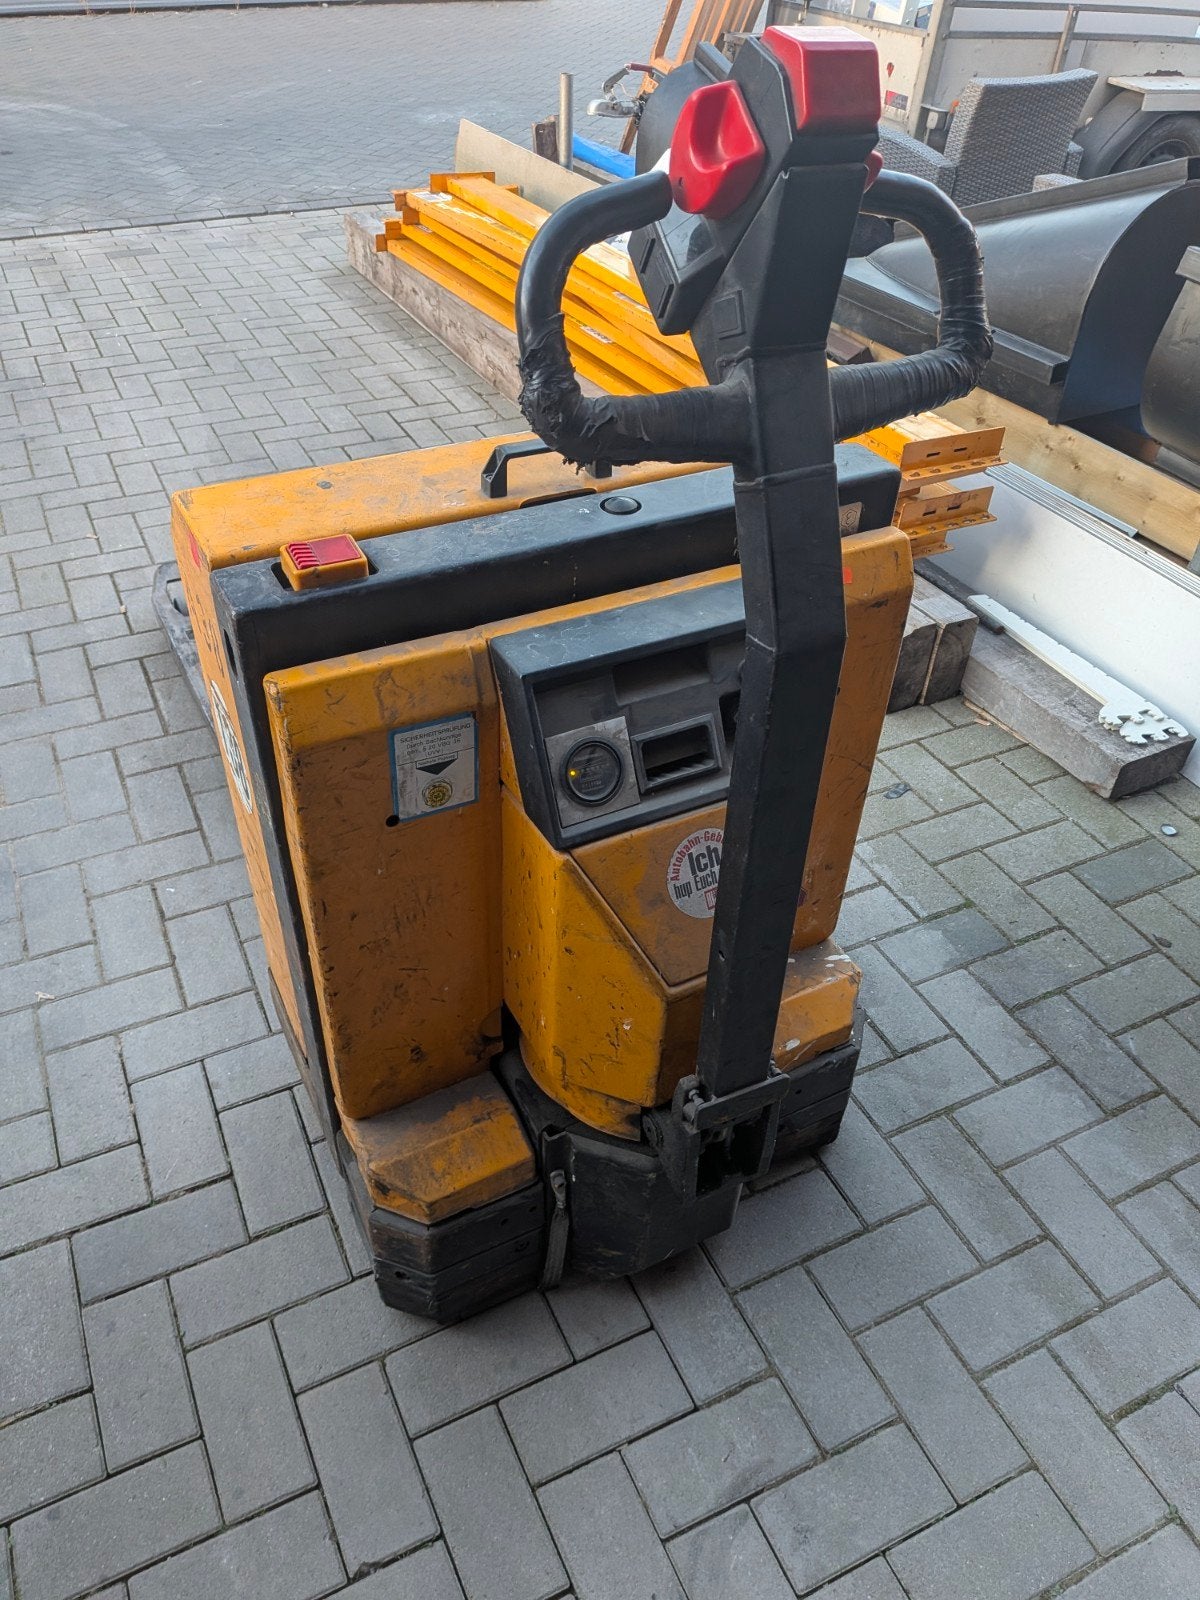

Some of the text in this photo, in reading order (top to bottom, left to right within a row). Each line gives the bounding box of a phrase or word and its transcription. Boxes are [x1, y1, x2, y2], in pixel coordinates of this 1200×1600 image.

[670, 831, 724, 881] Autobahn-Geb
[687, 845, 721, 876] Ich
[673, 882, 693, 900] hup
[694, 870, 718, 891] Euch
